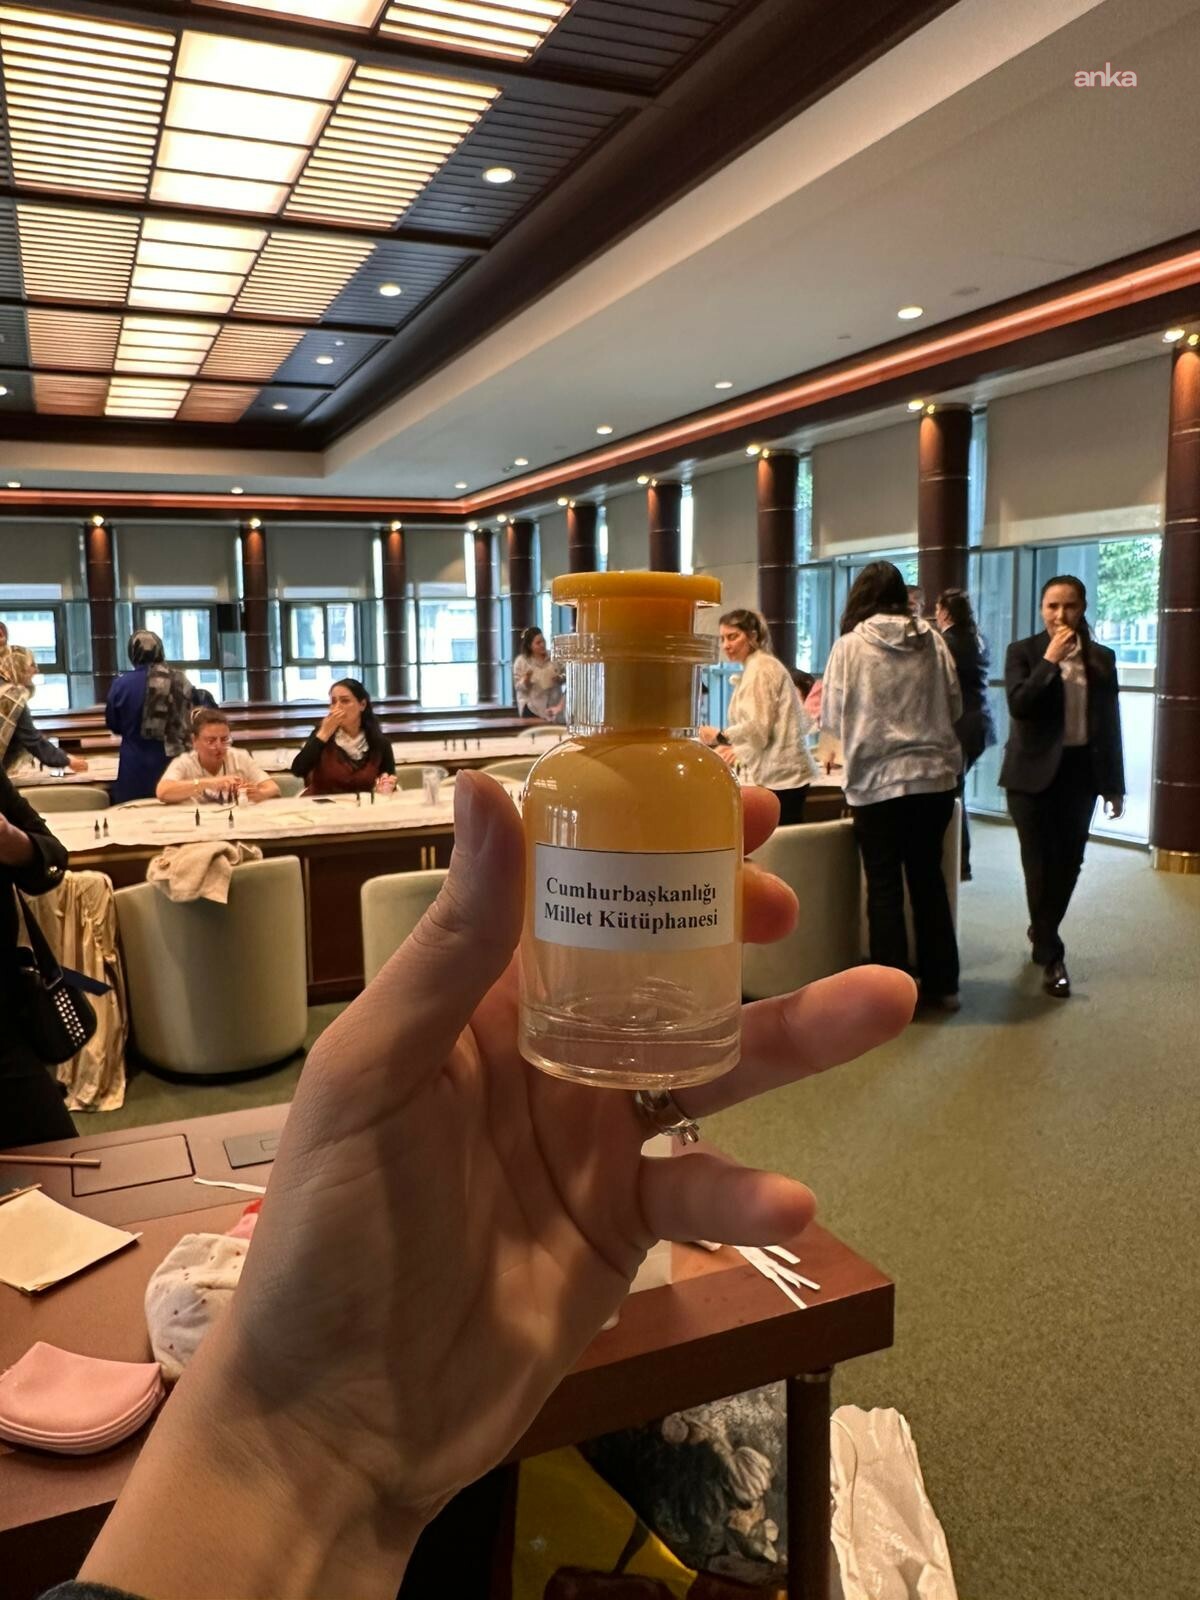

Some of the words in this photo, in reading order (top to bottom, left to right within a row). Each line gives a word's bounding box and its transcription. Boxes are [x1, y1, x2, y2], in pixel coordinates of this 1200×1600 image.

[546, 877, 716, 906] Cumhurbaşkanlığı
[544, 902, 593, 926] Millet
[599, 909, 718, 934] Kütüphanesi
